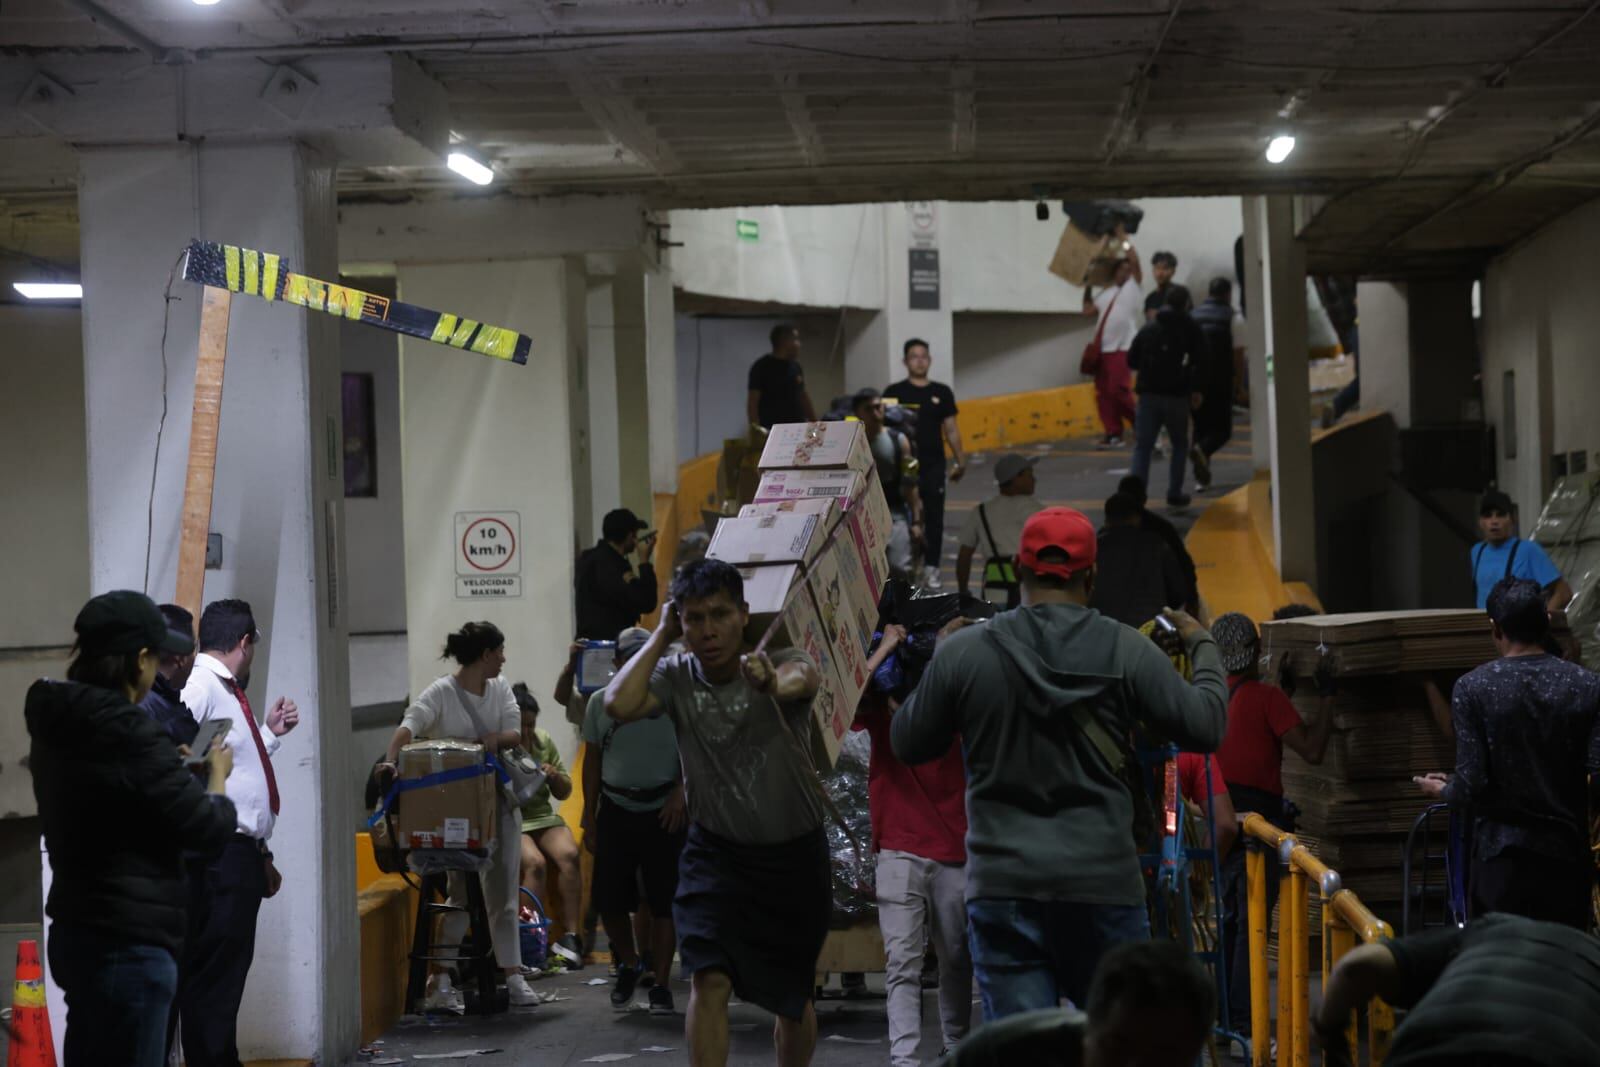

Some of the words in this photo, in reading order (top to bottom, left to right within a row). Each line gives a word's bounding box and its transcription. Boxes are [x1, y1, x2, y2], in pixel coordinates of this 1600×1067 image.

[480, 527, 498, 539] 10
[469, 544, 507, 556] km/h
[463, 579, 514, 587] VELOCIDAD
[471, 588, 507, 596] MAXIMA
